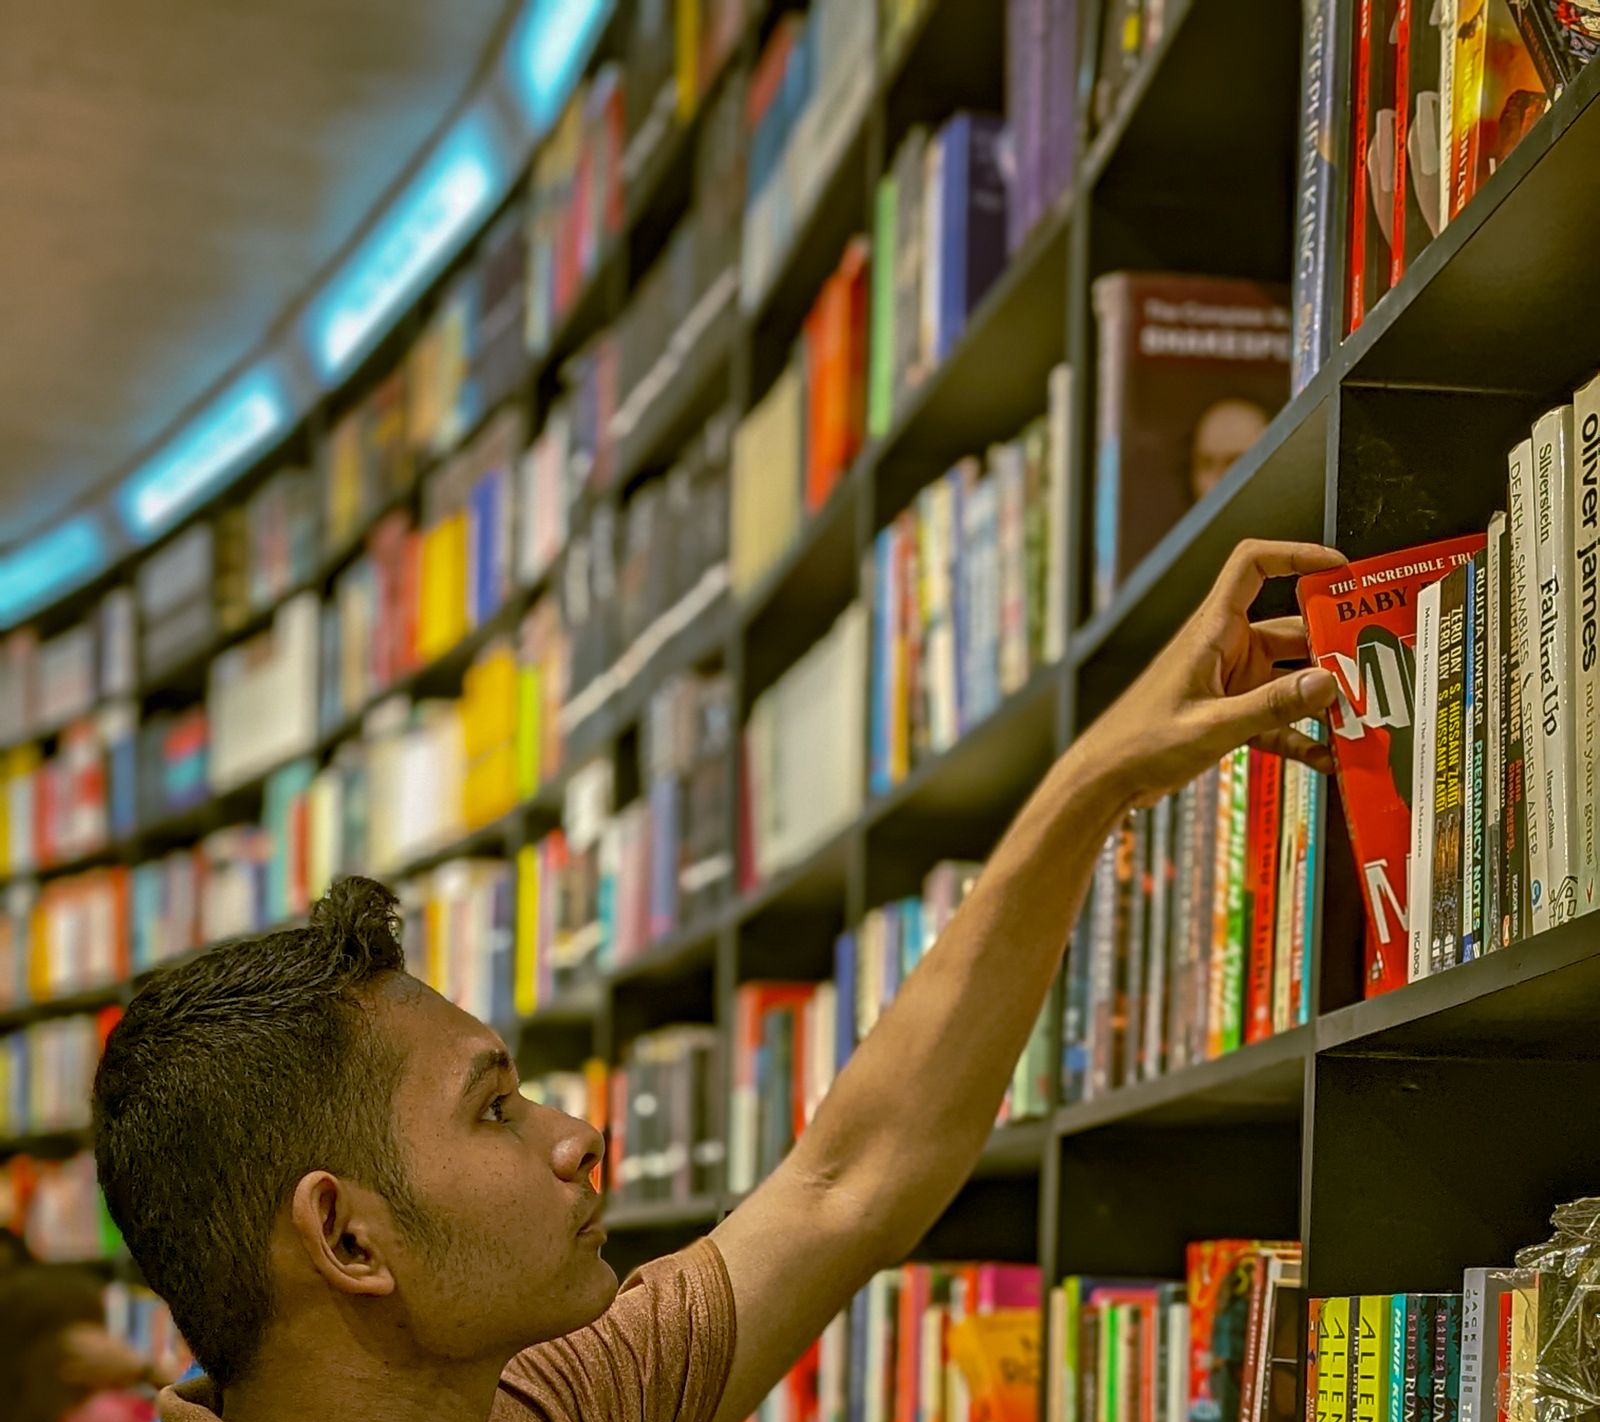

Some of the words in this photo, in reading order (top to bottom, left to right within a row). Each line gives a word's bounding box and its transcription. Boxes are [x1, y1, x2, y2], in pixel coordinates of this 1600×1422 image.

[1304, 16, 1323, 179] STEPHEN
[1509, 460, 1524, 532] DEATH
[1538, 442, 1552, 544] Silverstein
[1581, 412, 1600, 529] oliver
[1329, 580, 1358, 596] THE
[1362, 557, 1446, 588] INCREDIBLE
[1336, 585, 1410, 623] BABY
[1474, 566, 1486, 639] RUJUTA
[1439, 612, 1451, 651] ZERO
[1449, 604, 1463, 643] ZERO
[1514, 553, 1530, 665] SHAMBLES
[1539, 577, 1559, 690] Falling
[1576, 540, 1600, 673] james
[1438, 654, 1450, 680] DAY
[1449, 645, 1463, 673] DAY
[1474, 641, 1485, 727] DIWEKAR
[1500, 653, 1508, 719] Rebecca
[1437, 690, 1448, 705] S.
[1448, 683, 1461, 699] S.
[1510, 667, 1521, 745] PRINCE
[1541, 684, 1560, 737] Up
[1585, 680, 1595, 713] not
[1420, 720, 1428, 740] The
[1436, 709, 1449, 771] HUSSAIN
[1447, 700, 1461, 766] HUSSAIN
[1522, 701, 1537, 792] STEPHEN
[1585, 718, 1595, 739] in
[1435, 775, 1447, 813] ZAIDI
[1446, 768, 1459, 808] ZAIDI
[1472, 739, 1484, 861] PREGNANCY
[1515, 758, 1523, 802] Aruna
[1583, 750, 1595, 798] your
[1527, 799, 1539, 857] ALTER
[1545, 769, 1555, 849] HarperCollins
[1583, 803, 1596, 865] genes
[1471, 865, 1482, 931] NOTES
[1412, 930, 1421, 976] PICADOR
[1392, 1308, 1402, 1376] HANIF
[1463, 1288, 1471, 1342] CARR
[1470, 1289, 1479, 1342] JACK
